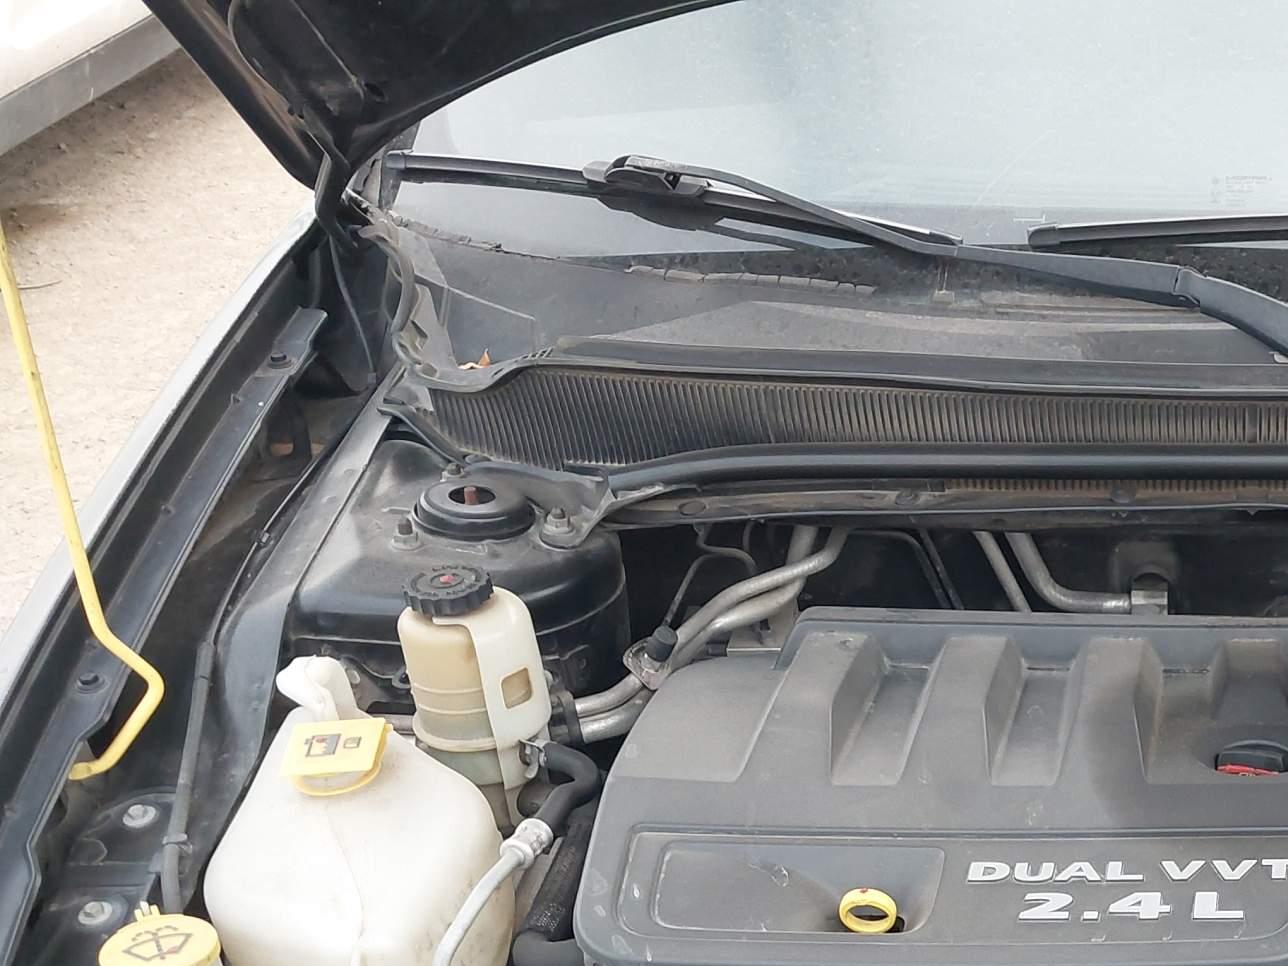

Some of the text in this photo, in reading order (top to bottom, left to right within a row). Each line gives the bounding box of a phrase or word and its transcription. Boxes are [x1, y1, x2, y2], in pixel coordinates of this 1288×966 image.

[967, 860, 1145, 883] DUAL
[1018, 891, 1245, 921] 2.4 L
